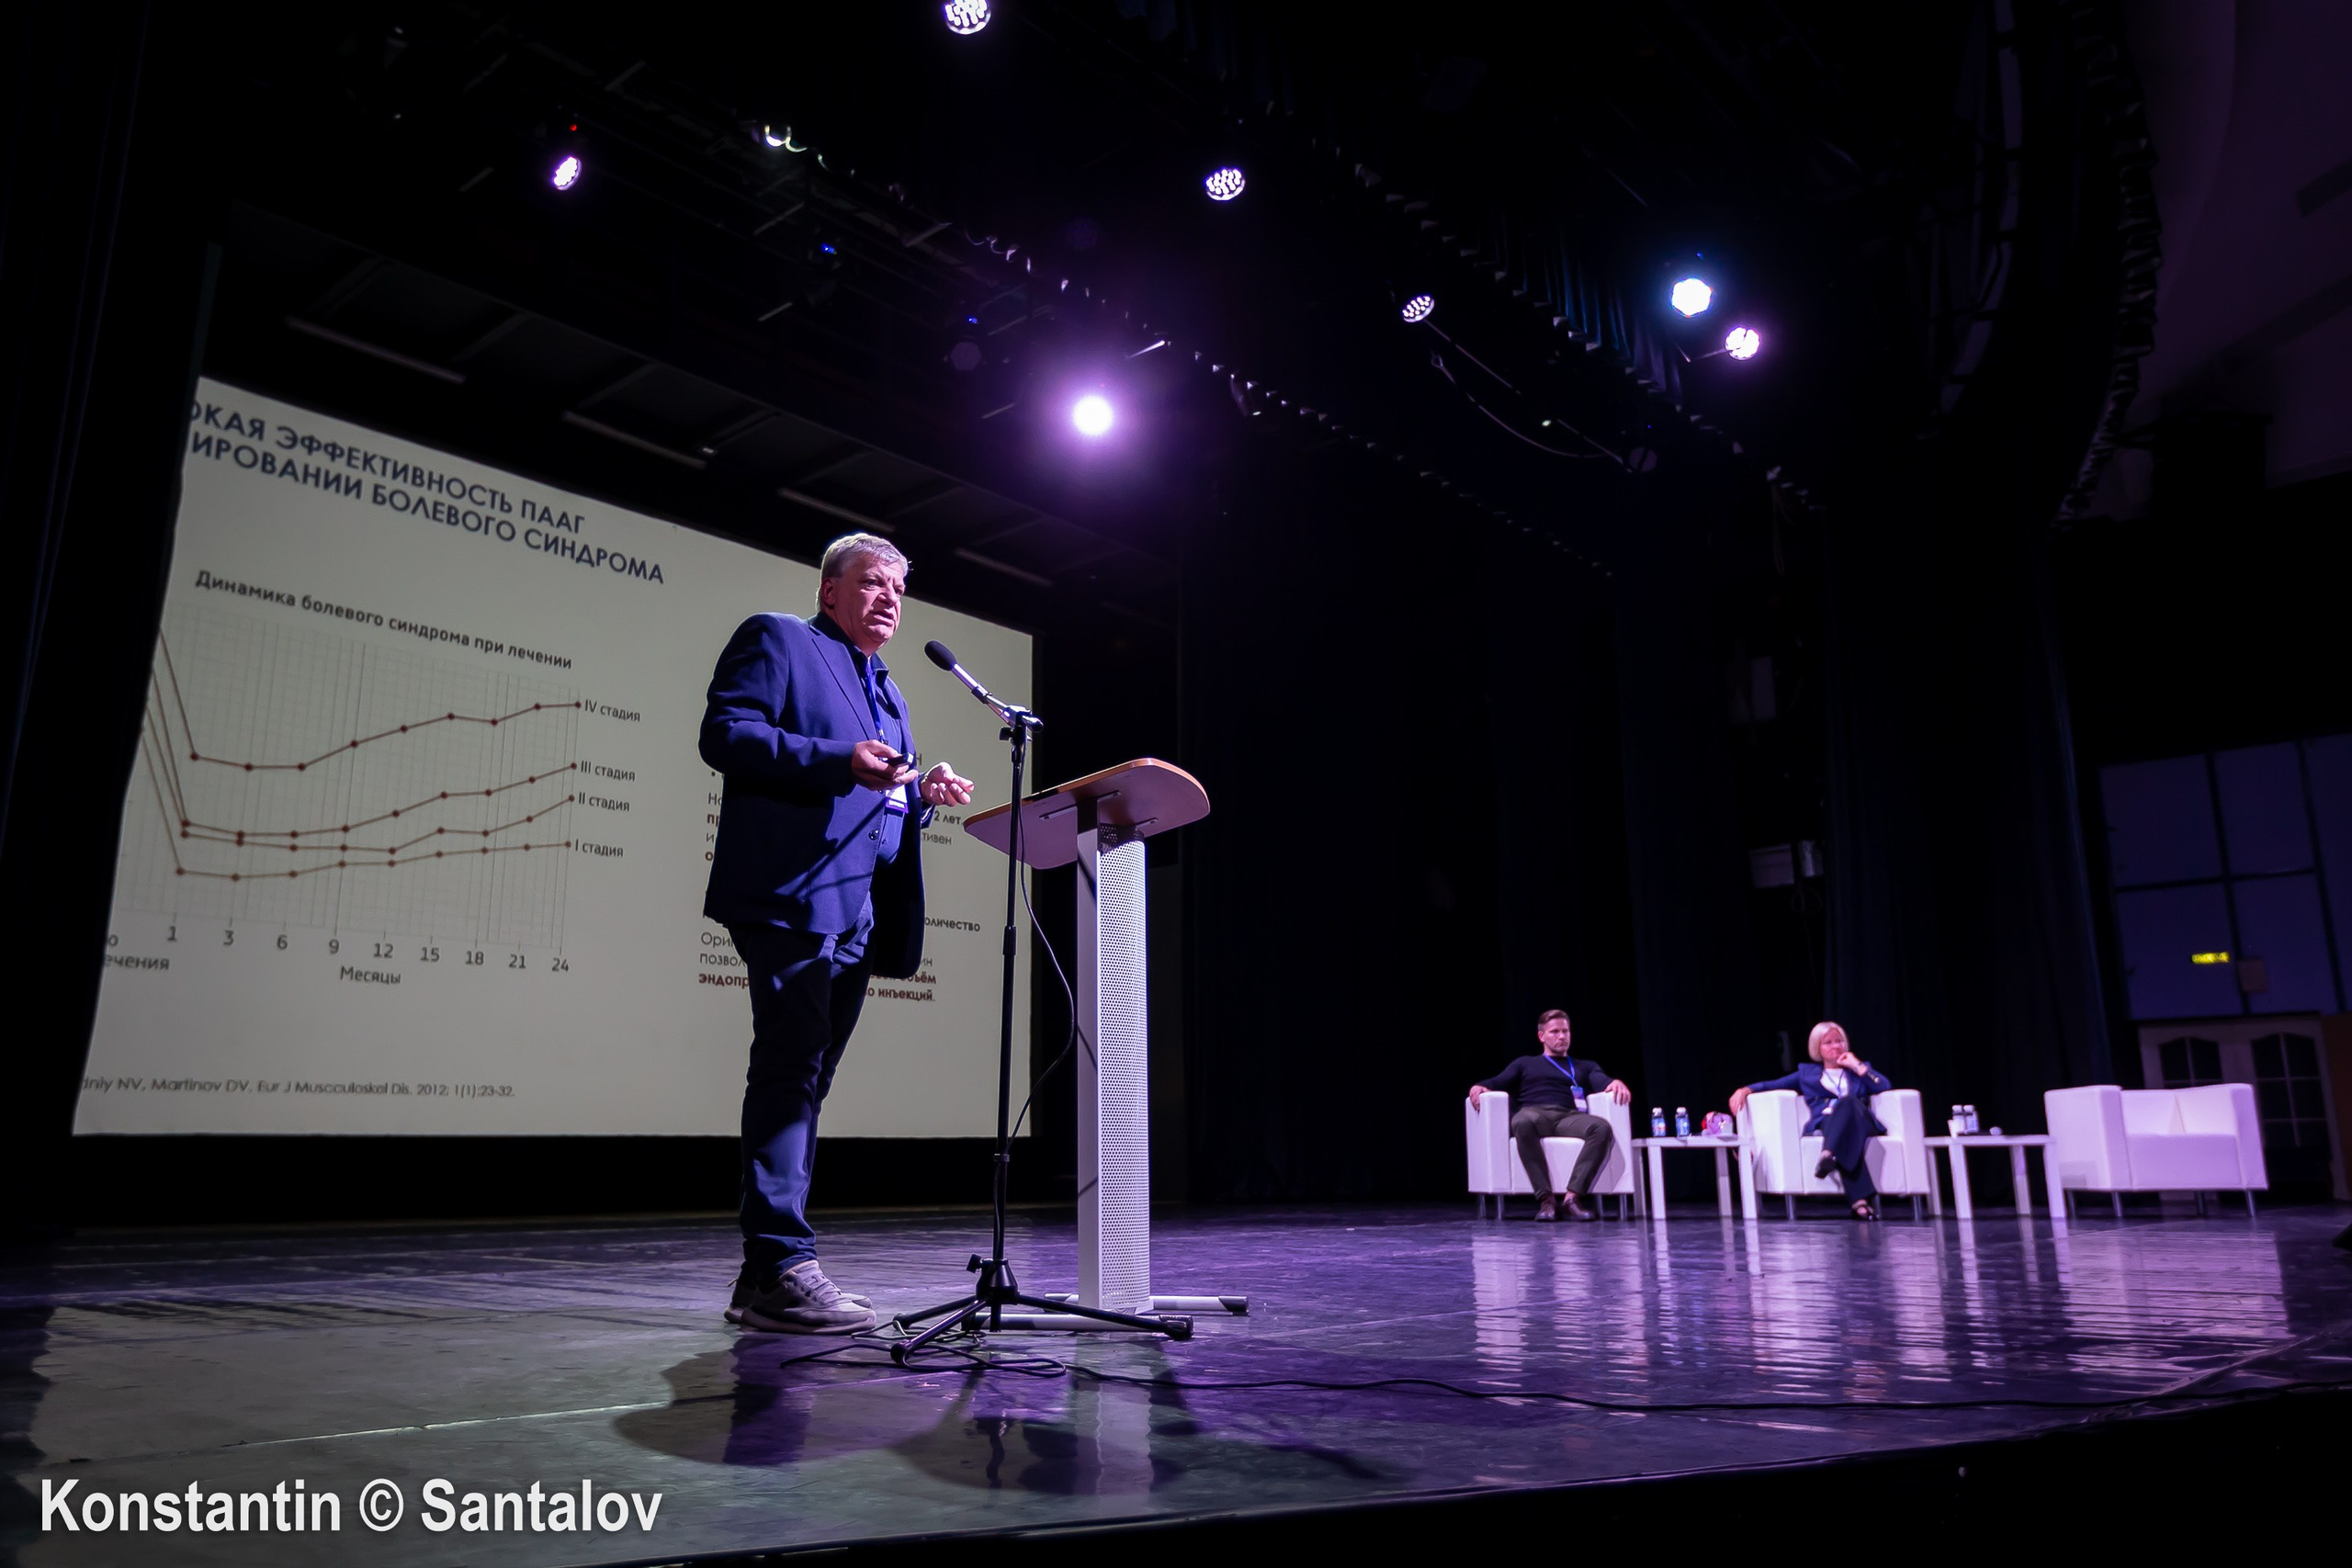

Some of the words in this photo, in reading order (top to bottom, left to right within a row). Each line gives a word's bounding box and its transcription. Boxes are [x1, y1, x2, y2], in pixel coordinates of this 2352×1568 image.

[276, 425, 513, 513] ЭФФЕКТИВНОСТЬ
[520, 499, 584, 534] ПААГ
[191, 431, 363, 500] ИРОВАНИИ
[372, 483, 516, 542] БОЛЕВОГО
[524, 528, 664, 584] СИНДРОМА
[196, 570, 295, 606] Динамика
[301, 595, 383, 626] болевого
[389, 617, 469, 646] синдрома
[474, 636, 504, 654] при
[507, 644, 572, 669] лечении
[584, 699, 598, 713] IV
[600, 705, 640, 722] стадия
[594, 765, 636, 782] стадия
[589, 795, 630, 812] стадия
[582, 842, 624, 858] стадия
[167, 926, 178, 942] 1
[223, 931, 234, 946] 3
[277, 935, 288, 950] 6
[328, 939, 340, 954] 9
[373, 942, 393, 958] 12
[420, 947, 440, 962] 15
[465, 951, 484, 965] 18
[508, 953, 526, 969] 21
[551, 957, 570, 973] 24
[340, 965, 401, 985] Месяцы
[151, 1077, 222, 1092] Martinov
